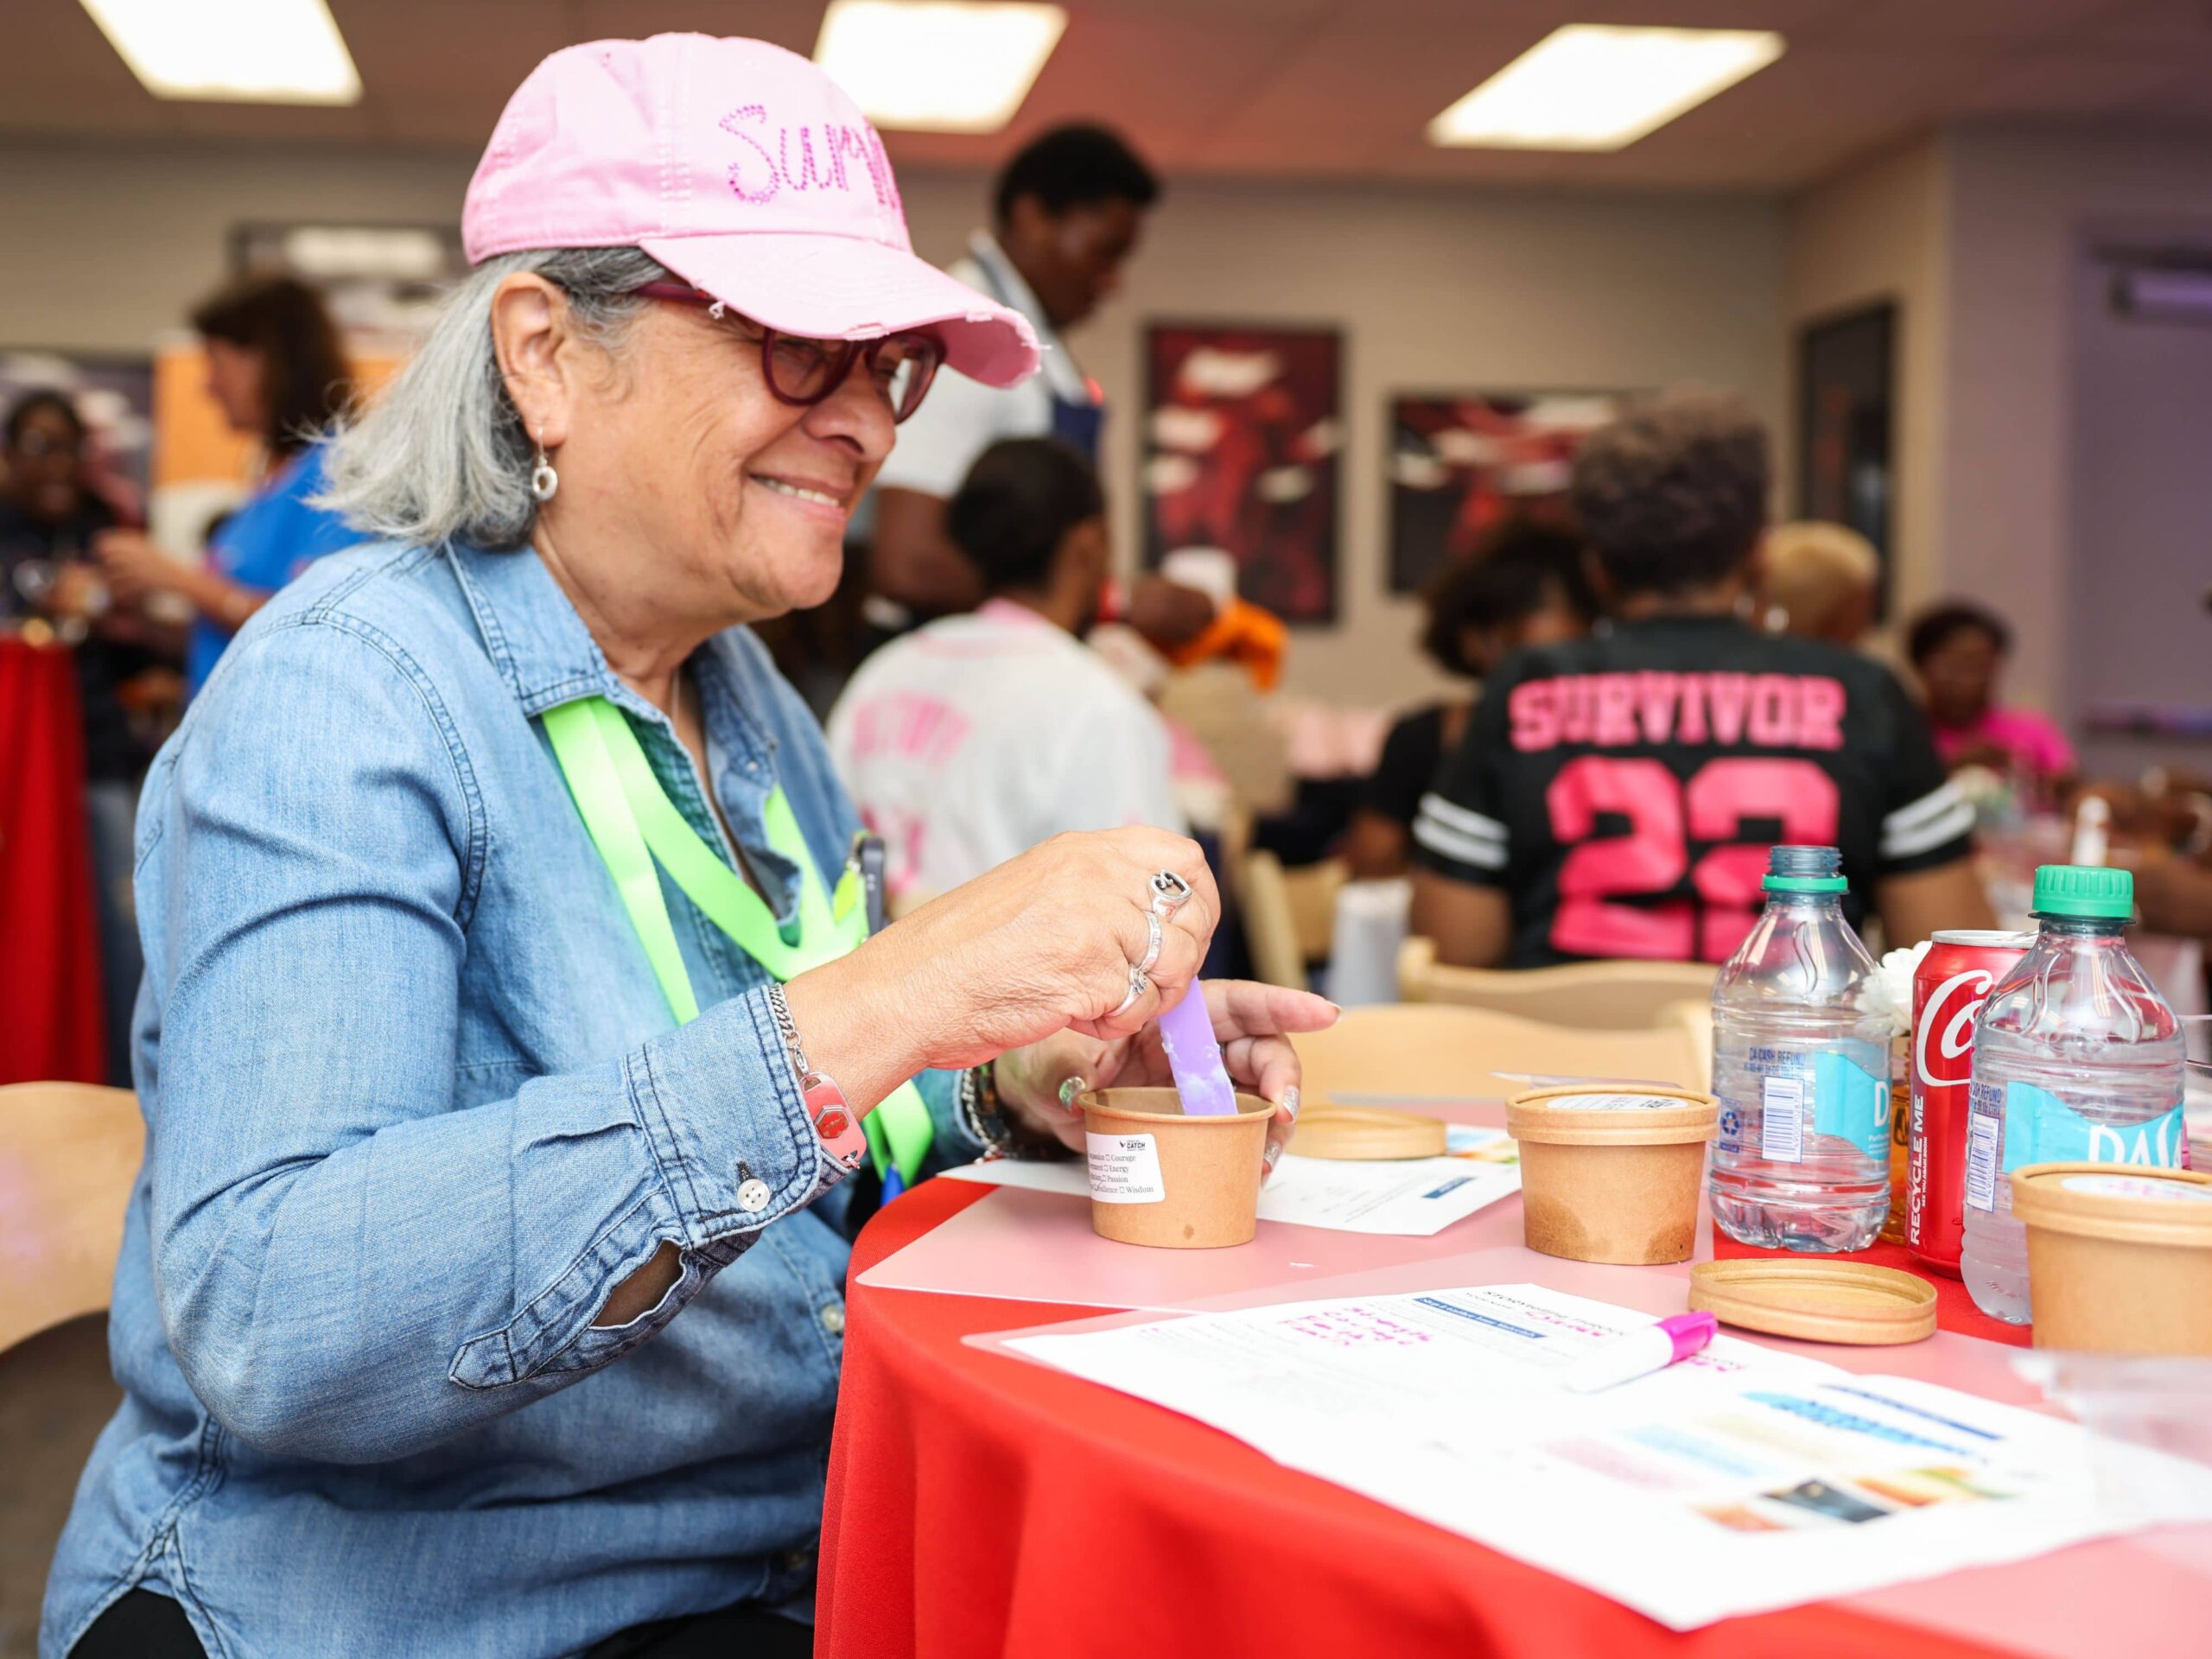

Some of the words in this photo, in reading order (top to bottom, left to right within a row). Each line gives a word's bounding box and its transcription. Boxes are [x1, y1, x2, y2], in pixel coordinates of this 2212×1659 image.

[1509, 670, 1847, 753] SURVIVOR
[1547, 754, 1841, 963] 22
[1914, 1095, 1923, 1133] ME
[1910, 1136, 1923, 1245] RECYCLE
